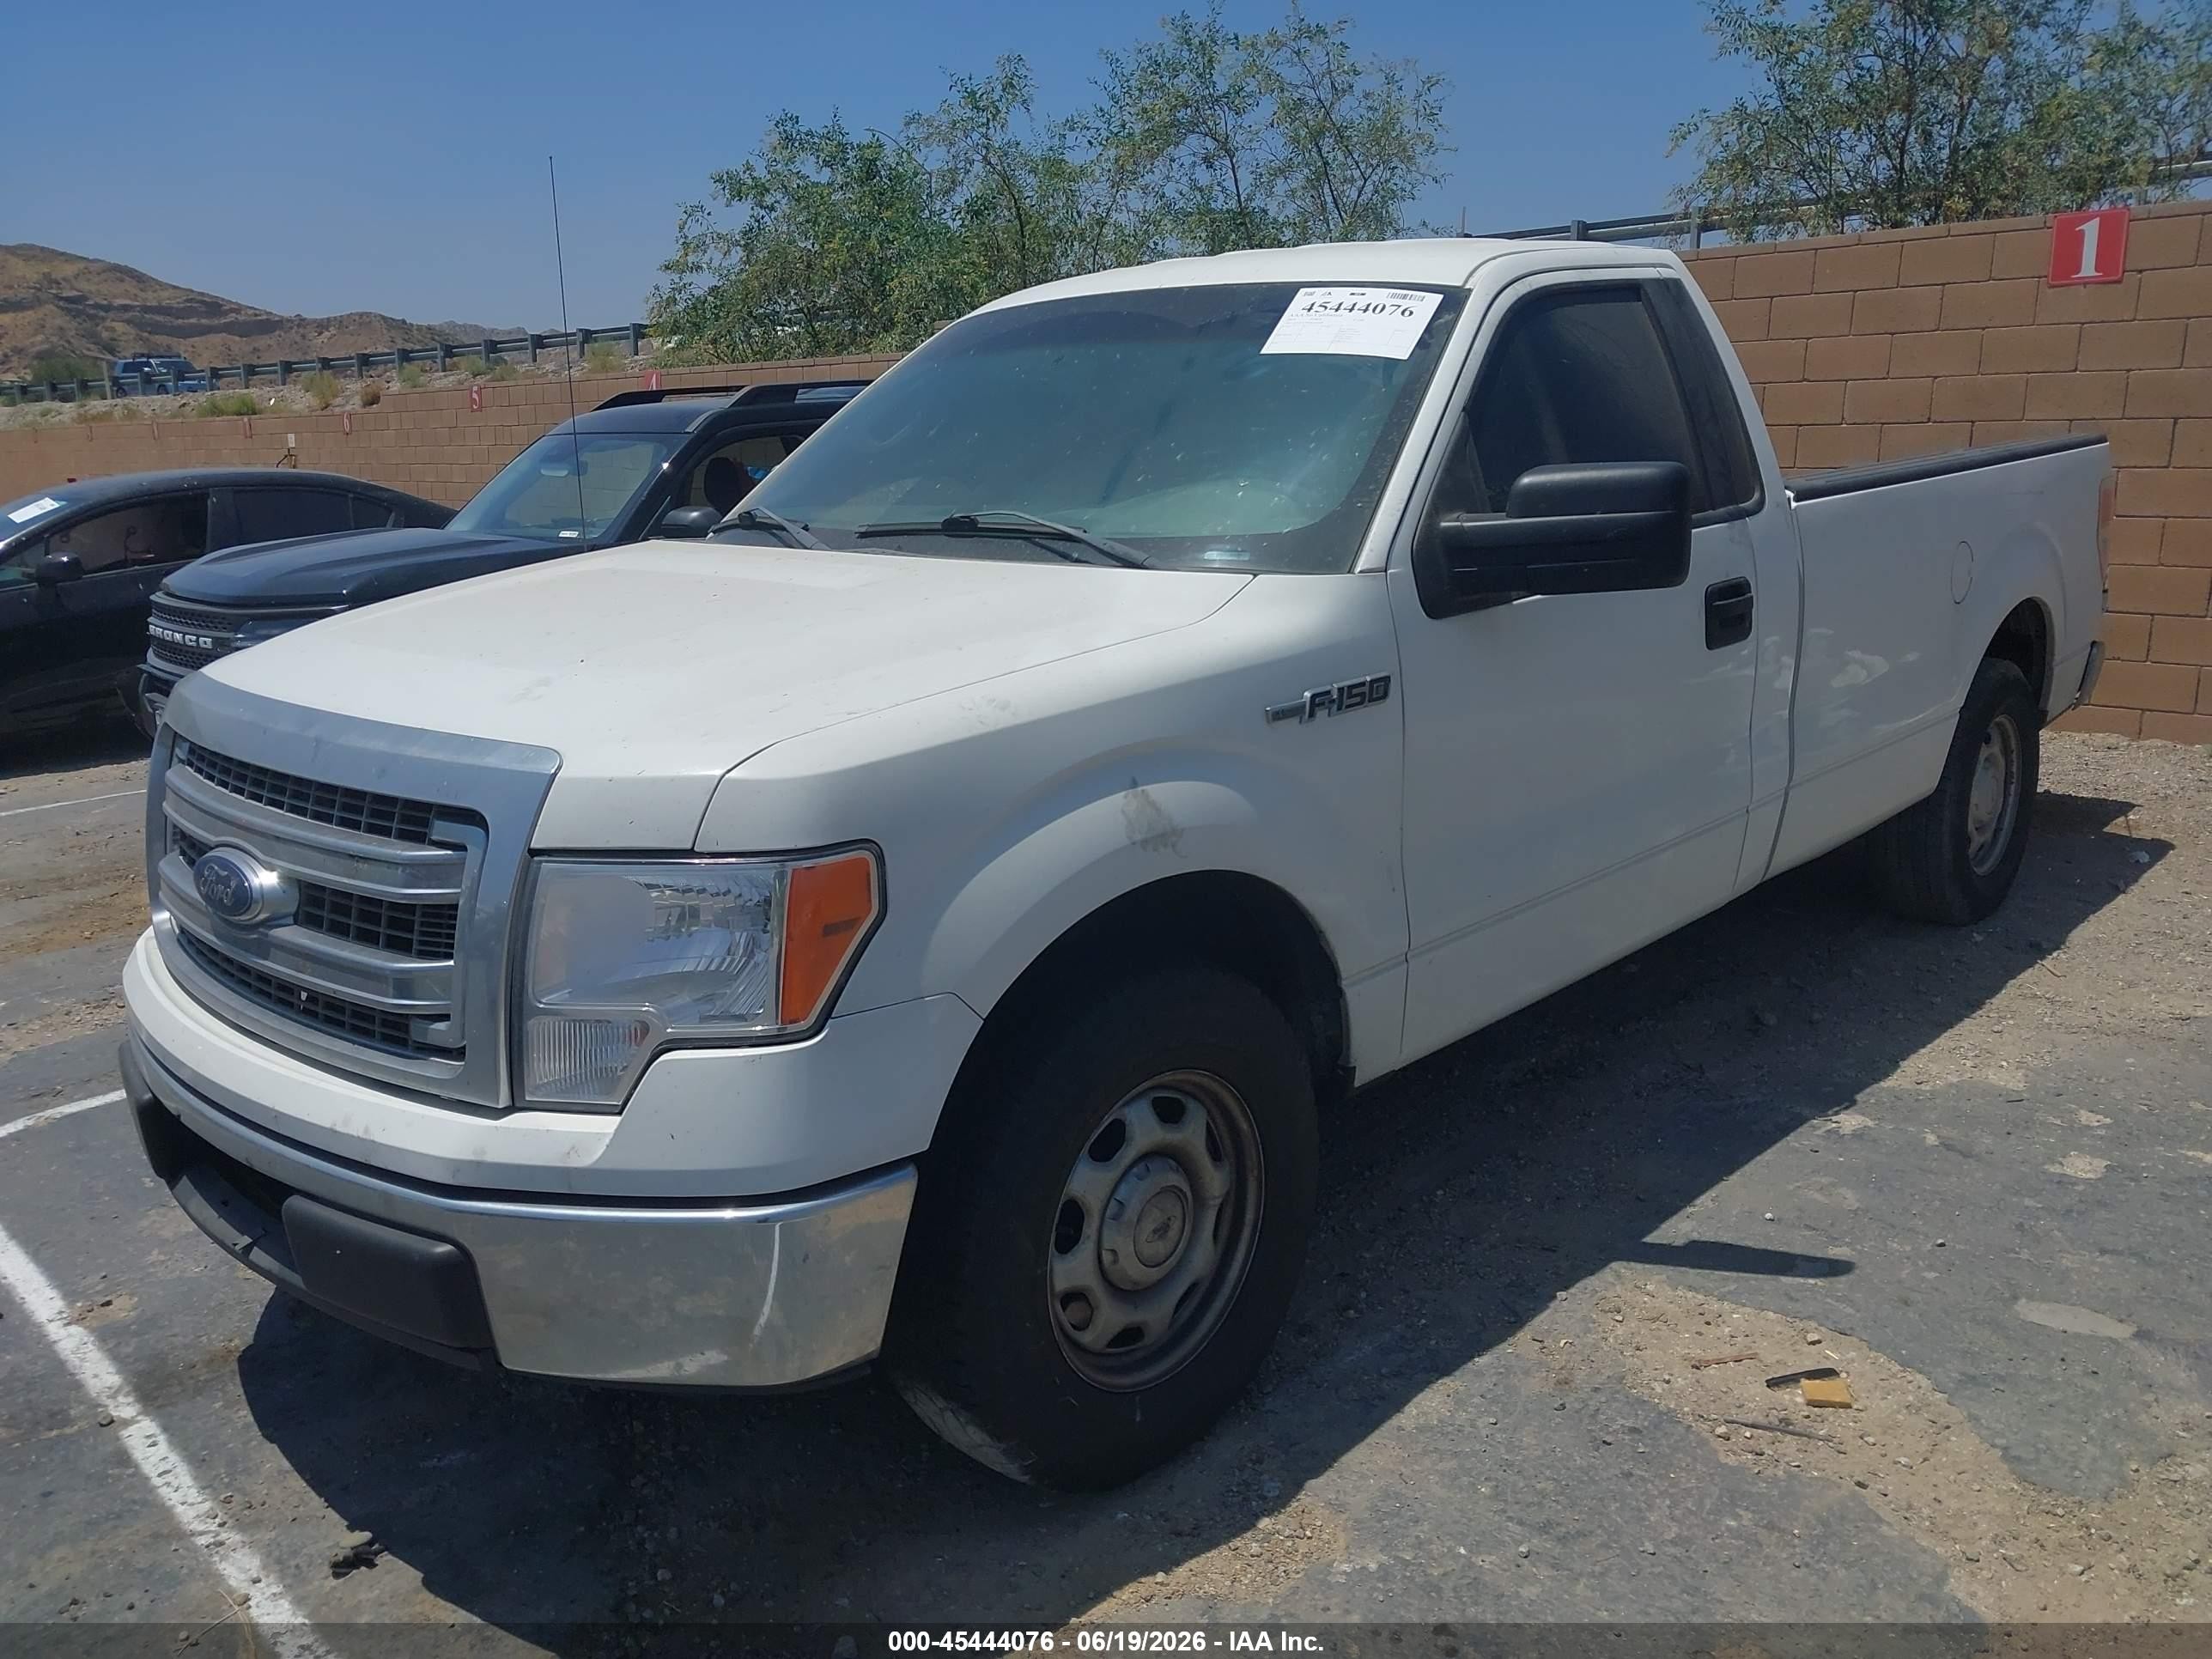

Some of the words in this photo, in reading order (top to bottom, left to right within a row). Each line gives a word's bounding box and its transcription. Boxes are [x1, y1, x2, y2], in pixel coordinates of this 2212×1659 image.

[2070, 216, 2103, 277] 1
[1301, 301, 1416, 318] 45444076
[471, 386, 479, 409] 5
[343, 412, 350, 433] 6
[149, 624, 213, 648] BRONCO
[198, 862, 238, 907] Ford
